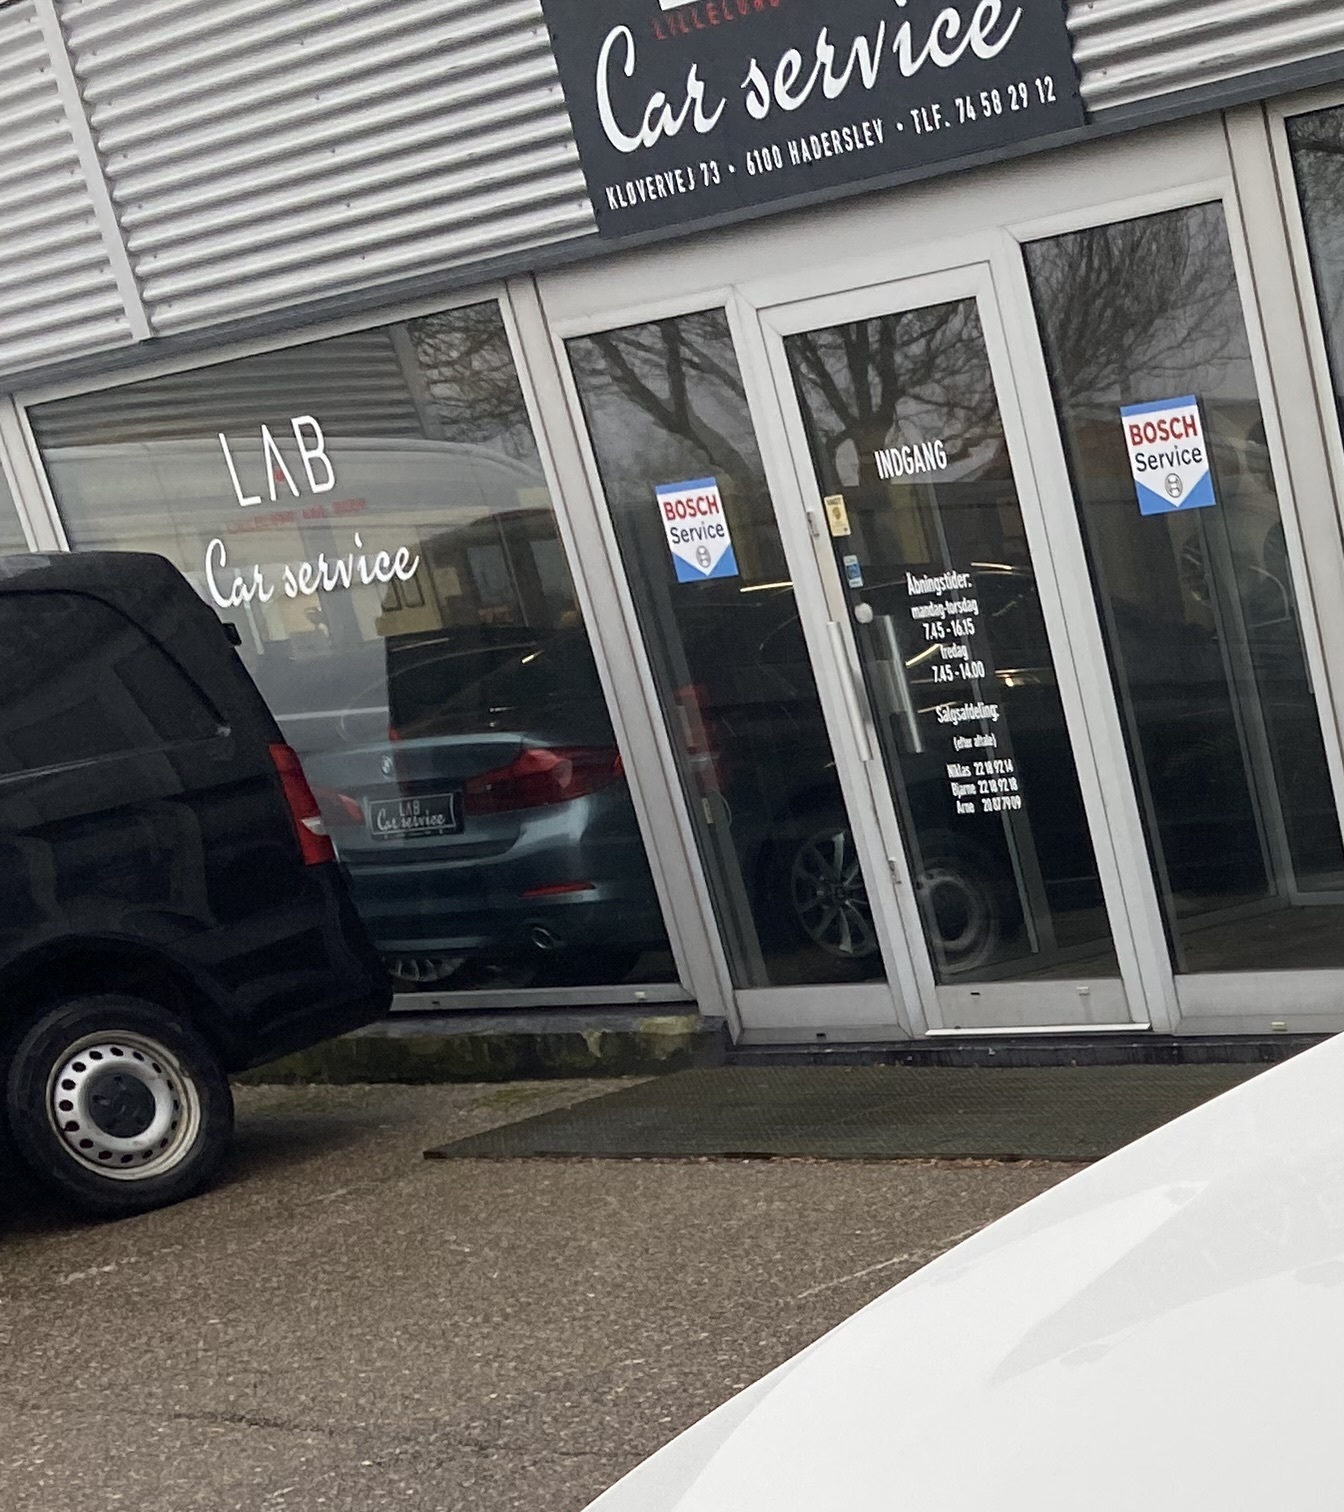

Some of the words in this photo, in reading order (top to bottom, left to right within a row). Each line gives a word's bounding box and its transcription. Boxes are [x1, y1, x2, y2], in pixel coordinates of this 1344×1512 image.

[596, 24, 728, 153] Car
[740, 0, 1023, 120] service
[605, 166, 696, 211] KLØVERVEJ
[700, 160, 721, 187] 73
[746, 144, 784, 176] 6100
[787, 118, 885, 166] HADERSLEV
[910, 104, 951, 134] TLF.
[954, 96, 977, 124] 74
[980, 89, 1003, 117] 58
[1008, 82, 1029, 110] 29
[1035, 75, 1057, 104] 12
[1128, 413, 1199, 447] BOSCH
[218, 415, 336, 507] LAB
[874, 438, 949, 480] INDGANG
[1134, 441, 1204, 473] Service
[663, 494, 719, 522] BOSCH
[669, 520, 726, 546] Service
[205, 537, 275, 608] Car
[281, 531, 420, 599] service
[905, 570, 973, 596] Åbningstider:
[910, 597, 979, 619] mandag-torsdag
[922, 621, 946, 641] 7.45
[951, 617, 976, 637] 16.15
[939, 642, 969, 661] fredag
[931, 664, 954, 684] 7.45
[959, 660, 986, 681] 14.00
[973, 761, 986, 776] 22
[977, 779, 990, 794] 22
